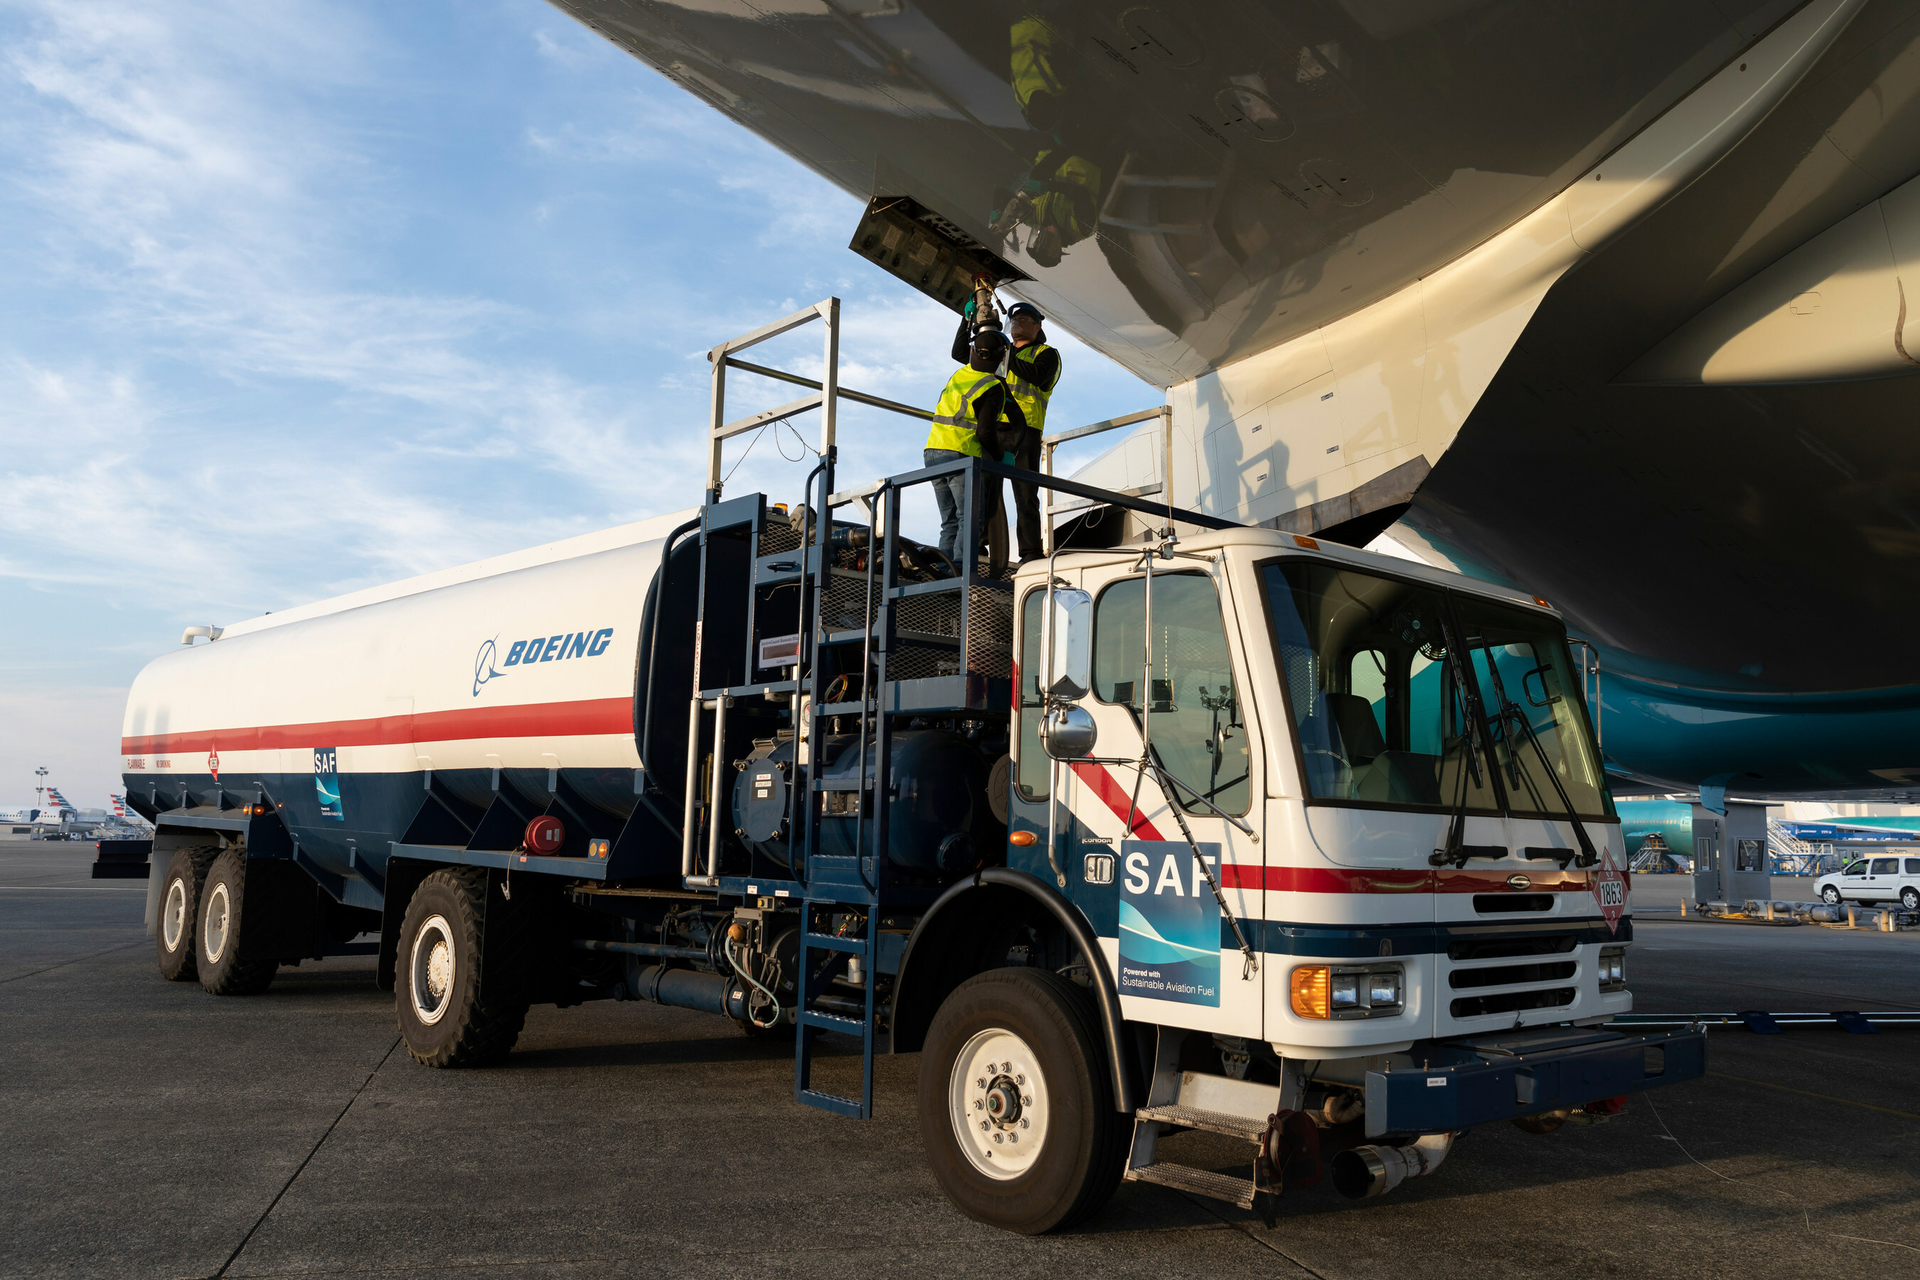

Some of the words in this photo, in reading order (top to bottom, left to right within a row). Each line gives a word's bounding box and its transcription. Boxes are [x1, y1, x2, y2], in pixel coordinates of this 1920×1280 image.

[503, 628, 614, 667] BOEING
[315, 753, 336, 774] SAF
[1123, 851, 1216, 898] SAF
[1601, 882, 1623, 905] 1863
[1610, 910, 1617, 921] 3
[1123, 967, 1148, 977] Powered
[1148, 970, 1161, 978] with
[1122, 976, 1165, 990] Sustainable
[1165, 981, 1196, 995] Aviation
[1197, 984, 1215, 997] Fuel
